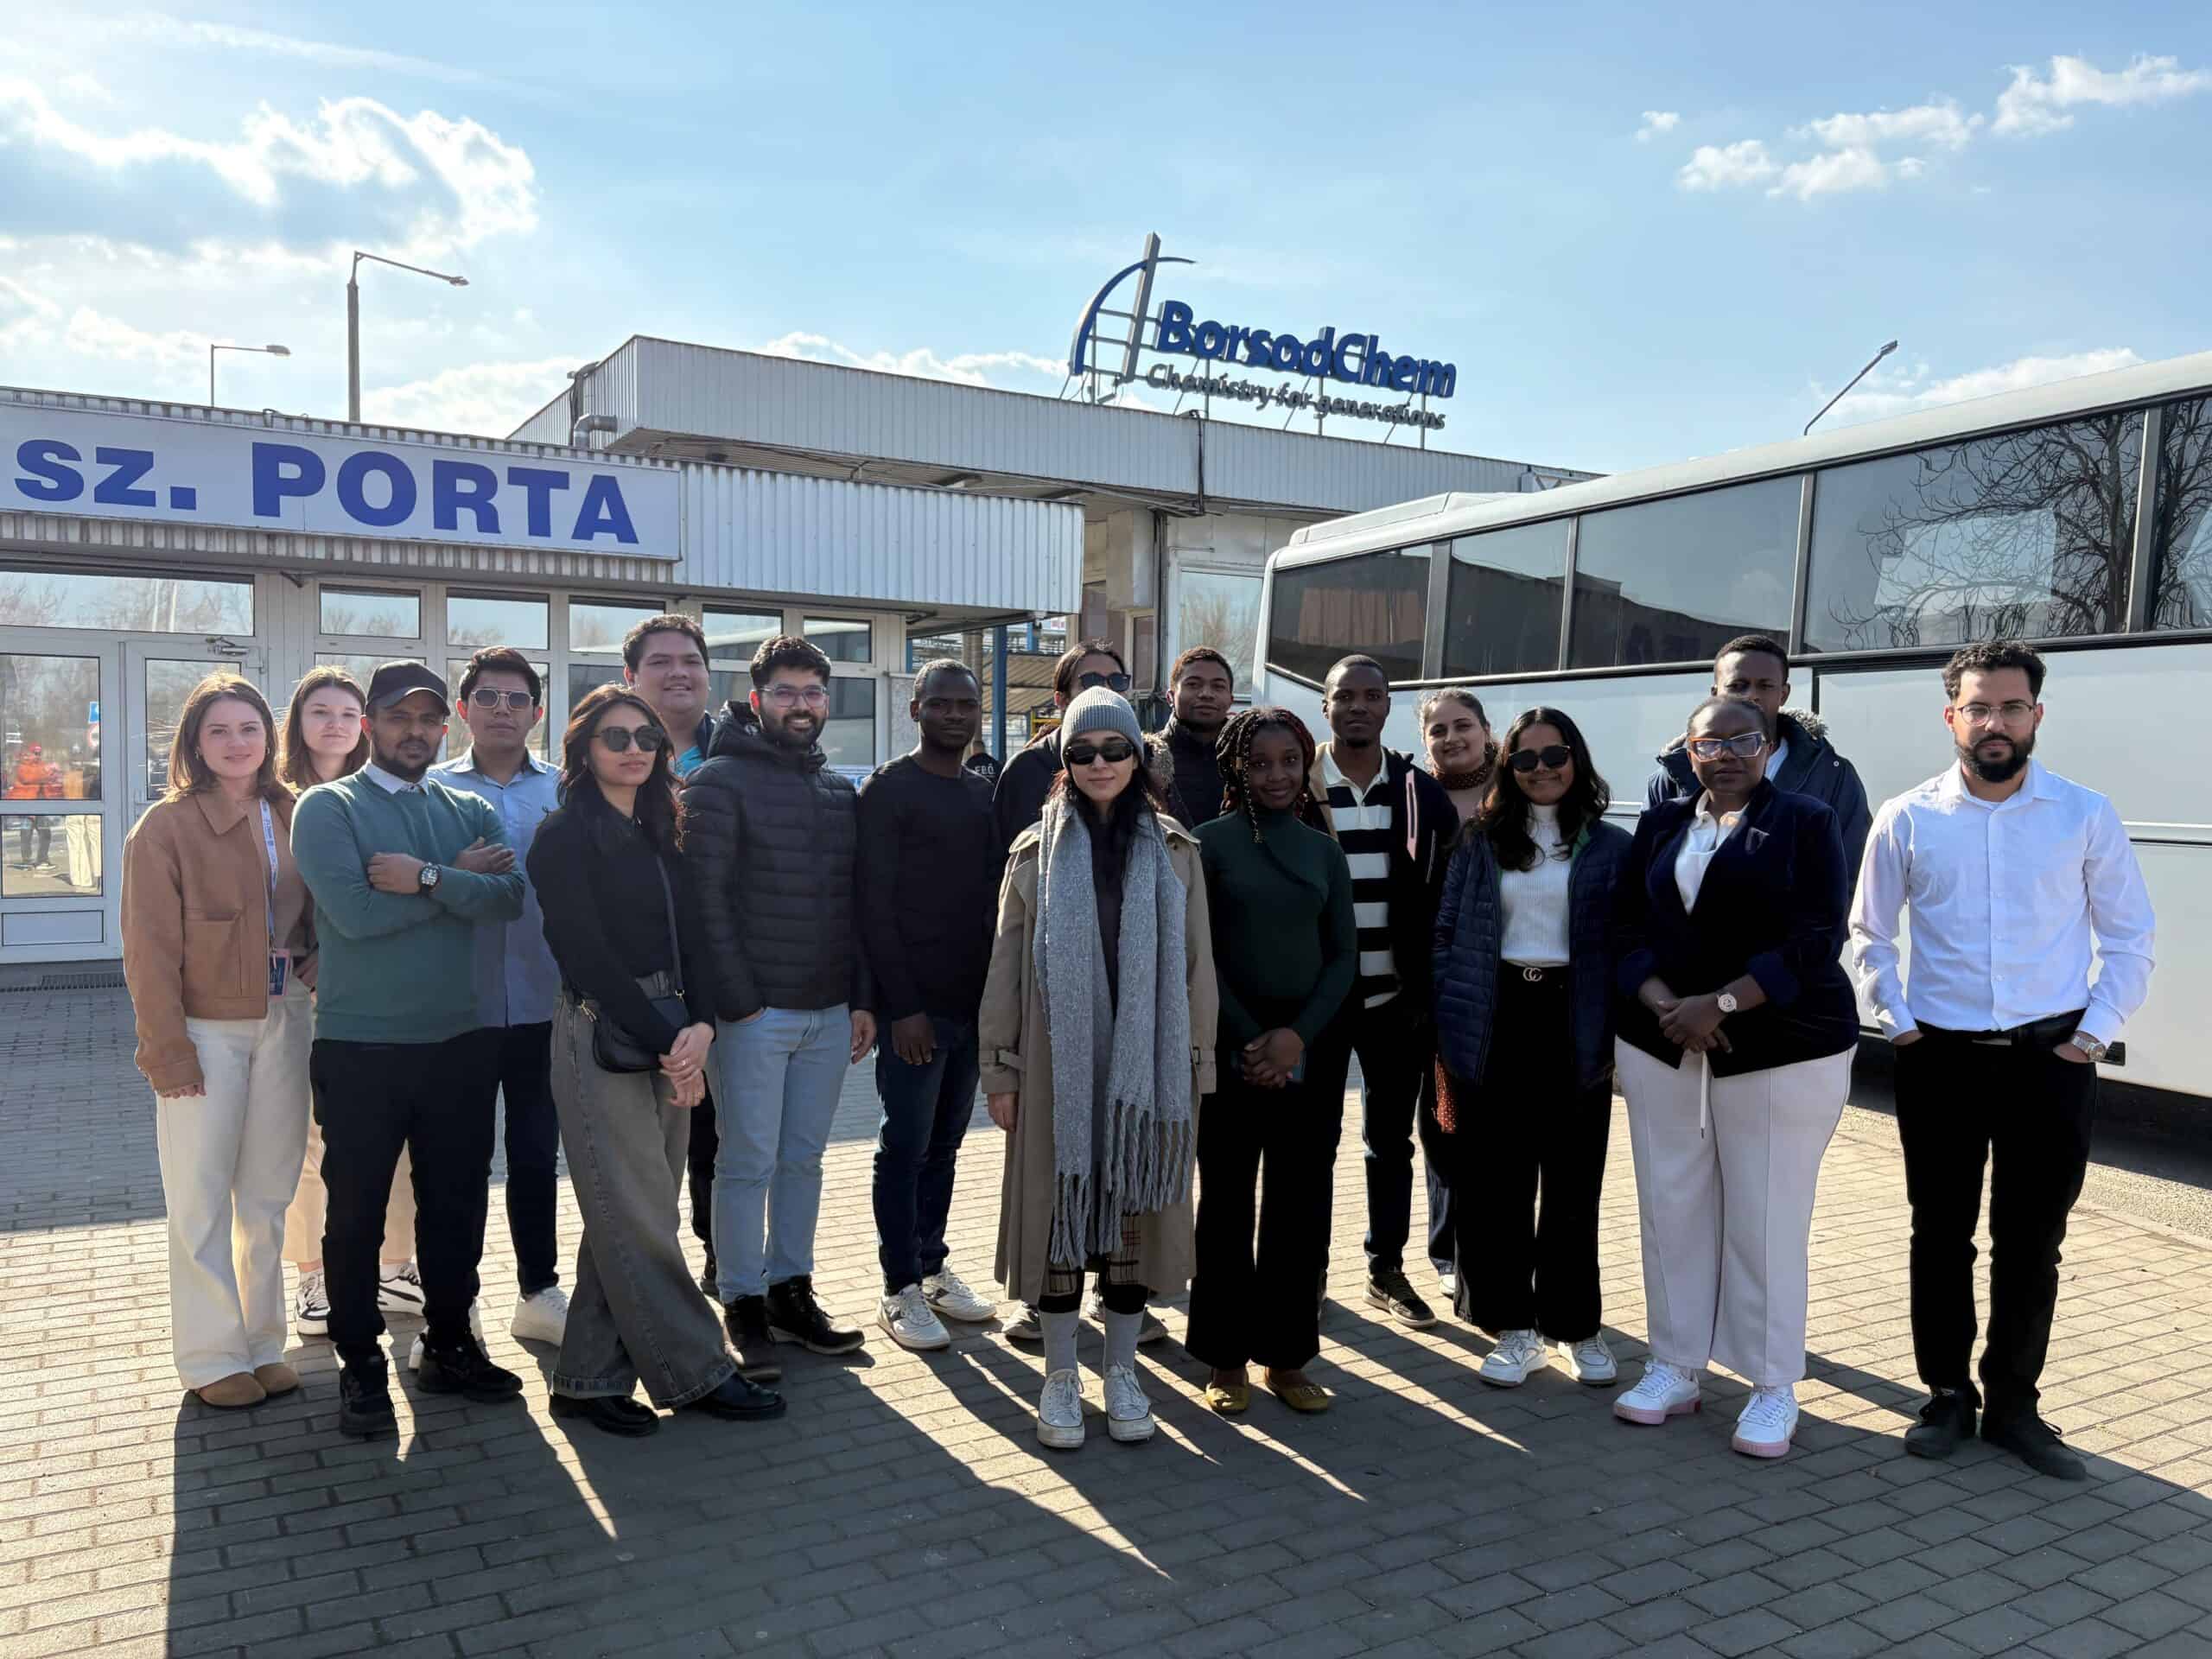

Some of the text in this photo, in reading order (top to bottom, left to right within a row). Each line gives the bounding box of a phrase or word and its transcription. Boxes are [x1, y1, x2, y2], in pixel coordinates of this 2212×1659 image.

[1147, 364, 1446, 429] Chemistry for generations
[1156, 300, 1457, 398] BorsodChem
[251, 442, 639, 544] PORTA
